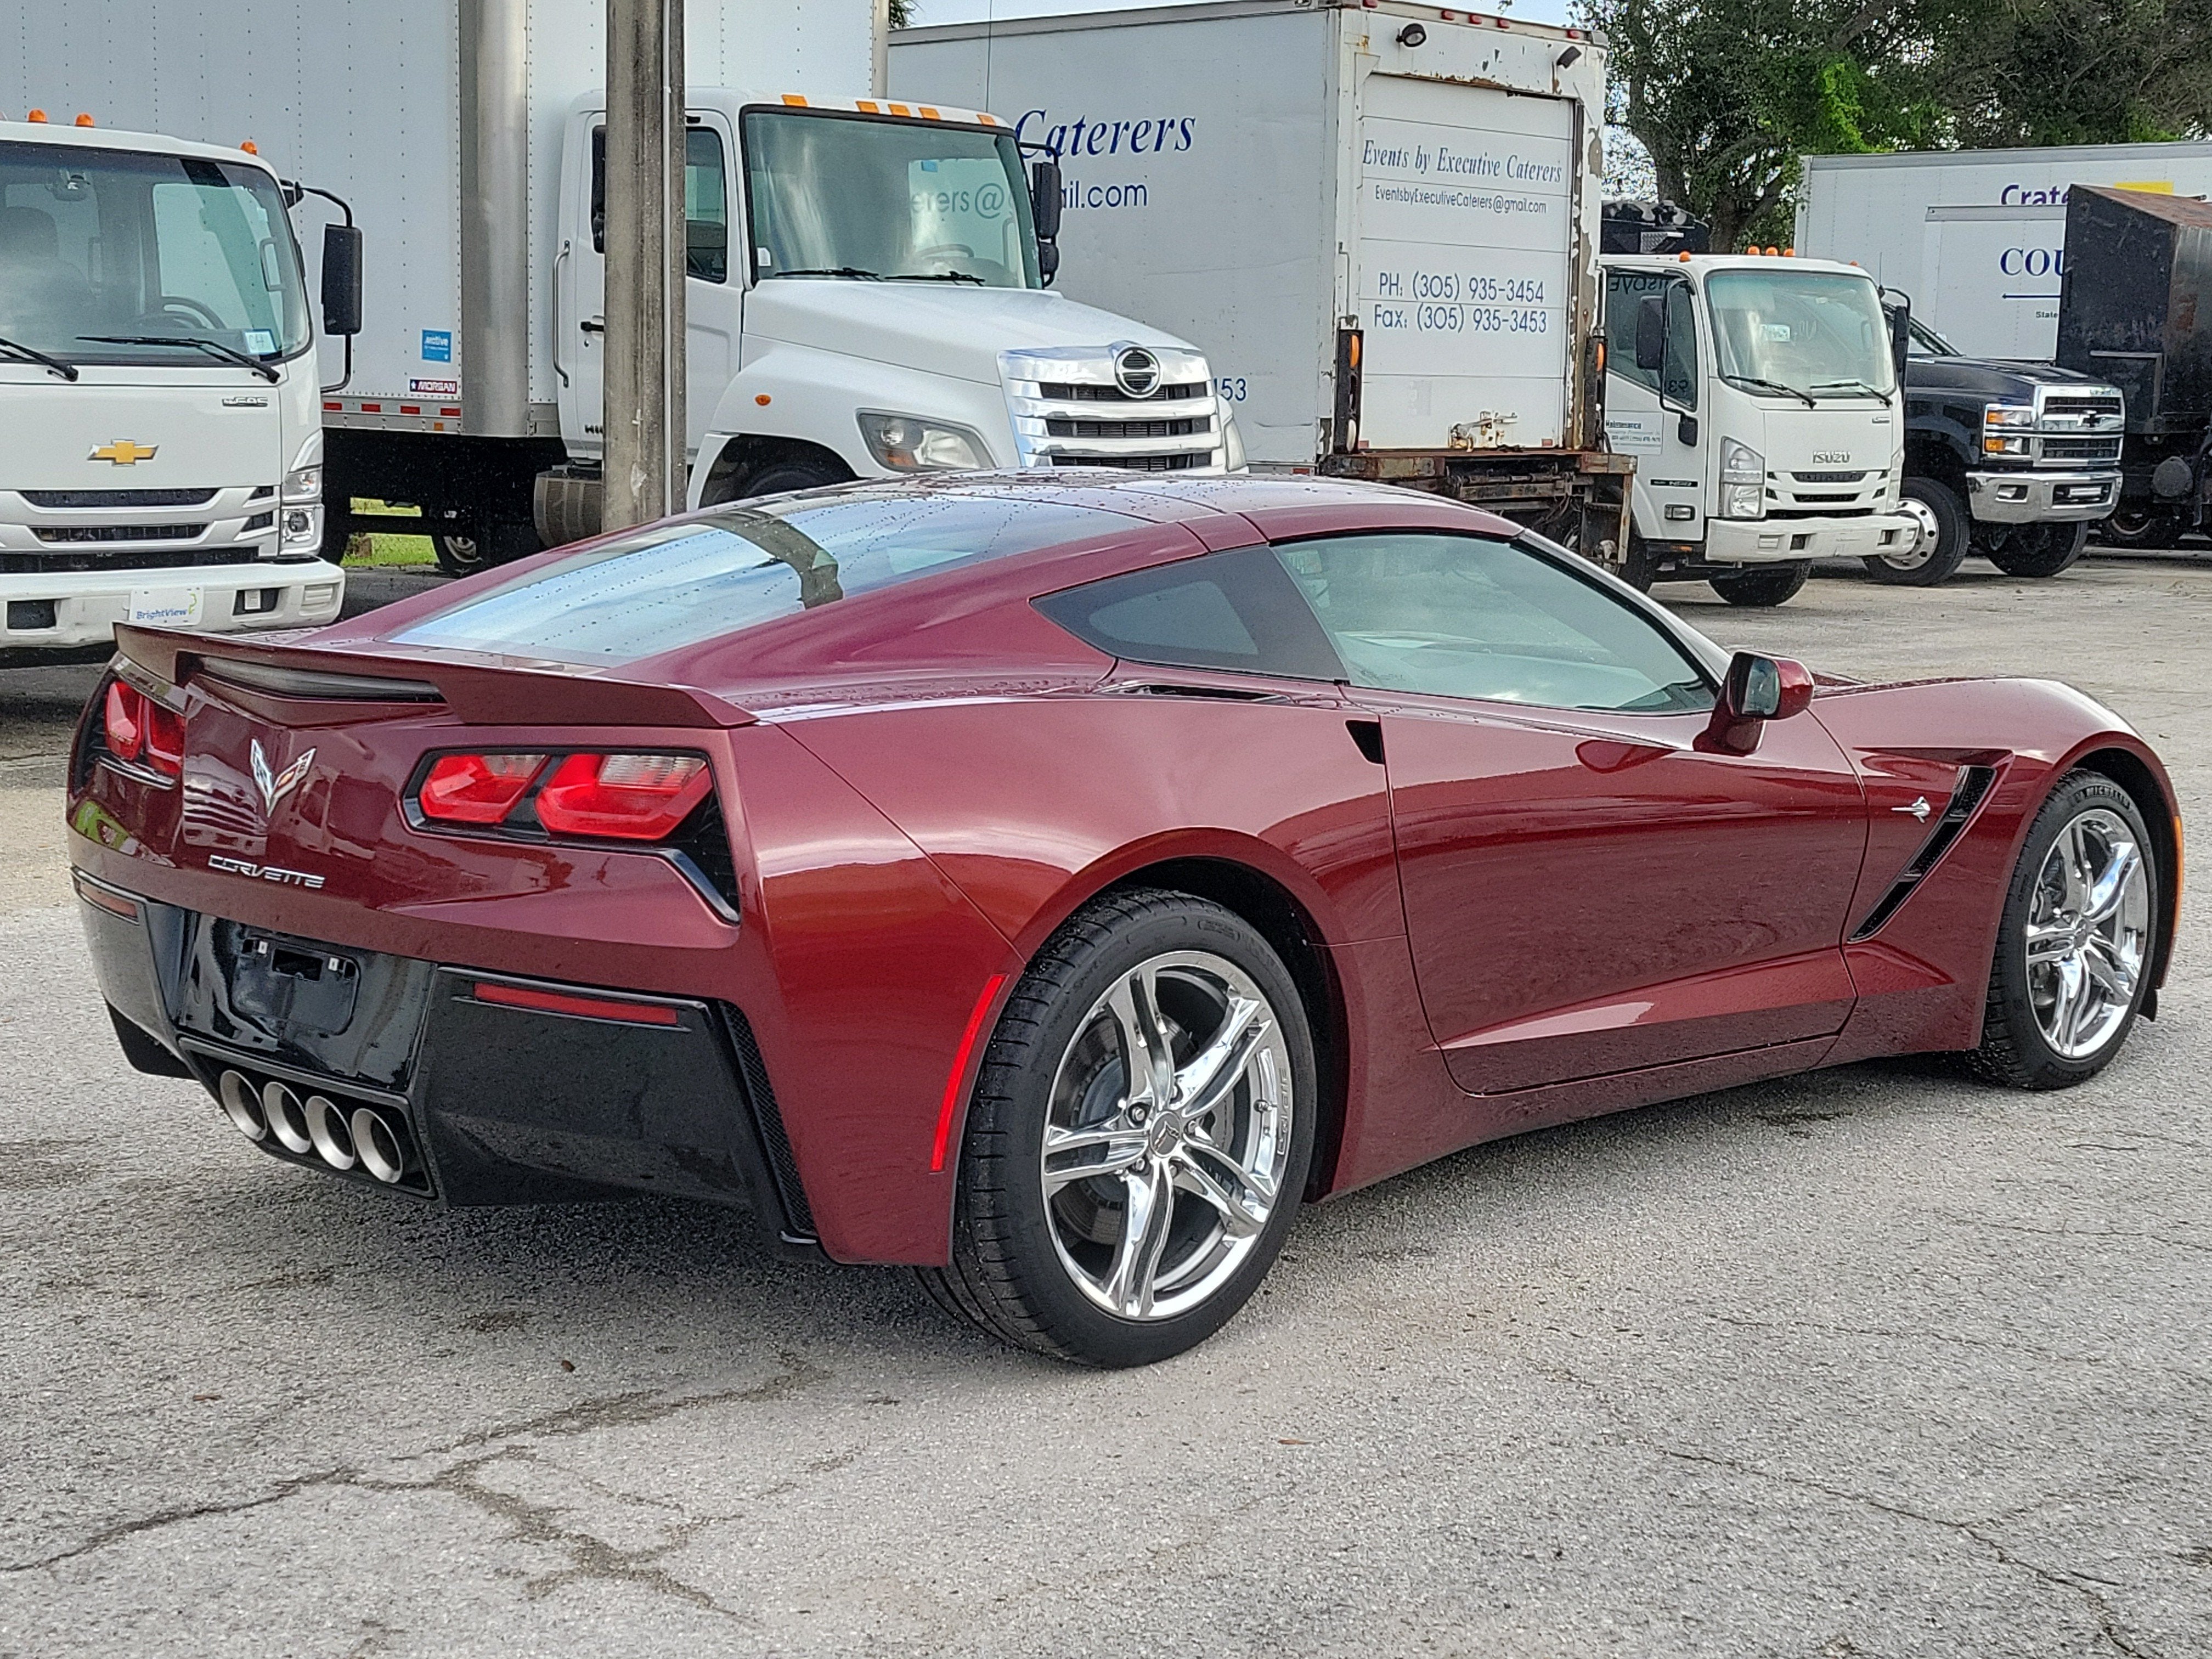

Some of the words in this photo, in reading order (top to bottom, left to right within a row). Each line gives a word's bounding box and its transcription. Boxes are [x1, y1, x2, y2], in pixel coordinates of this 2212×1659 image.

[1016, 110, 1196, 159] Caterers
[1362, 139, 1409, 168] Events
[1414, 145, 1431, 174] by
[1437, 147, 1501, 177] Executive
[1506, 155, 1562, 183] Caterers
[1375, 184, 1547, 213] EventsbyExecutiveCaterers@gmail.com
[1379, 272, 1403, 297] PH:
[1413, 270, 1460, 301] (305)
[1469, 276, 1545, 303] 935-3454
[1374, 303, 1408, 329] Fax:
[1417, 302, 1464, 334] (305)
[1473, 308, 1547, 333] 935-3453
[417, 380, 456, 392] MORGAN
[1813, 450, 1851, 464] ISUZU
[136, 608, 188, 620] BrightView
[207, 854, 326, 889] CORVETTE
